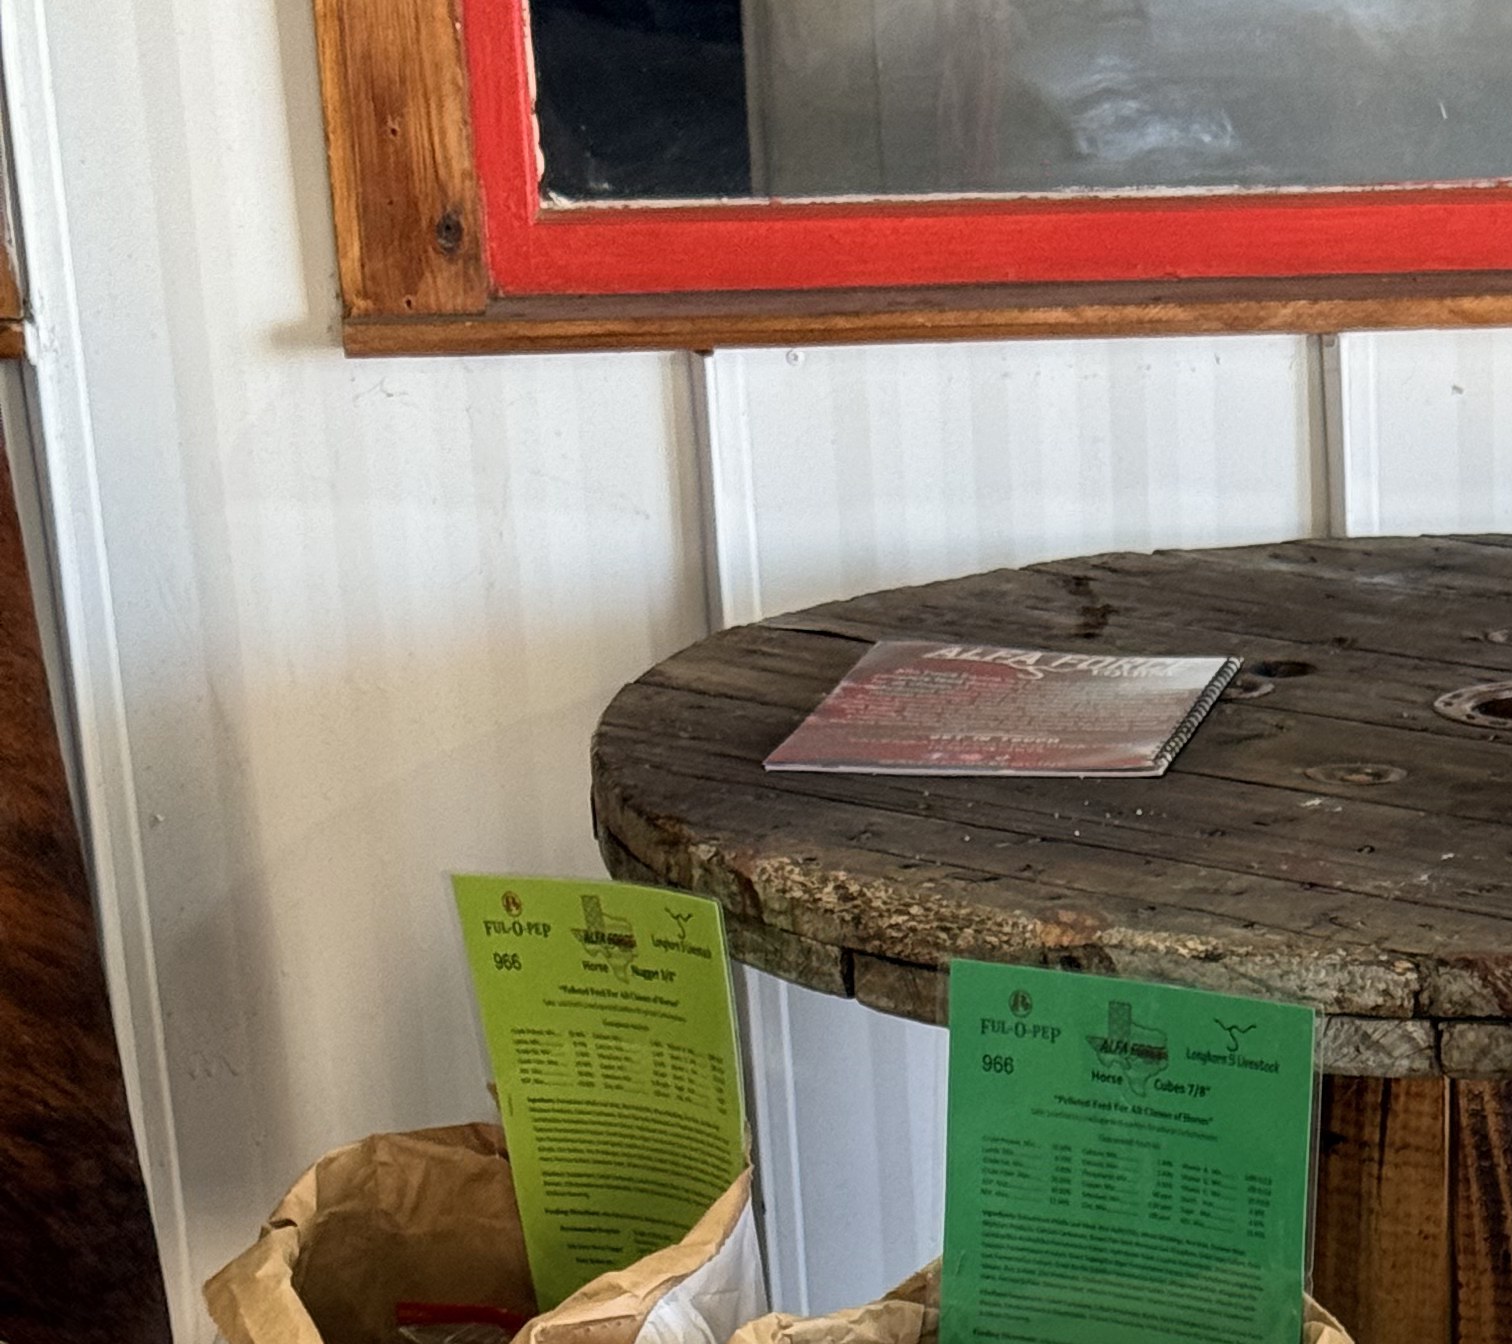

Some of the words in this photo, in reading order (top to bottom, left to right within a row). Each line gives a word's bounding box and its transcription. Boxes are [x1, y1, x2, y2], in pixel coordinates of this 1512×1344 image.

[922, 647, 1042, 665] ALFA
[980, 1018, 1061, 1043] FUL-O-PEP
[982, 1054, 1015, 1074] 966
[1091, 1070, 1123, 1086] Horse
[1154, 1078, 1186, 1094] Cubes
[1188, 1083, 1212, 1098] 7/8"
